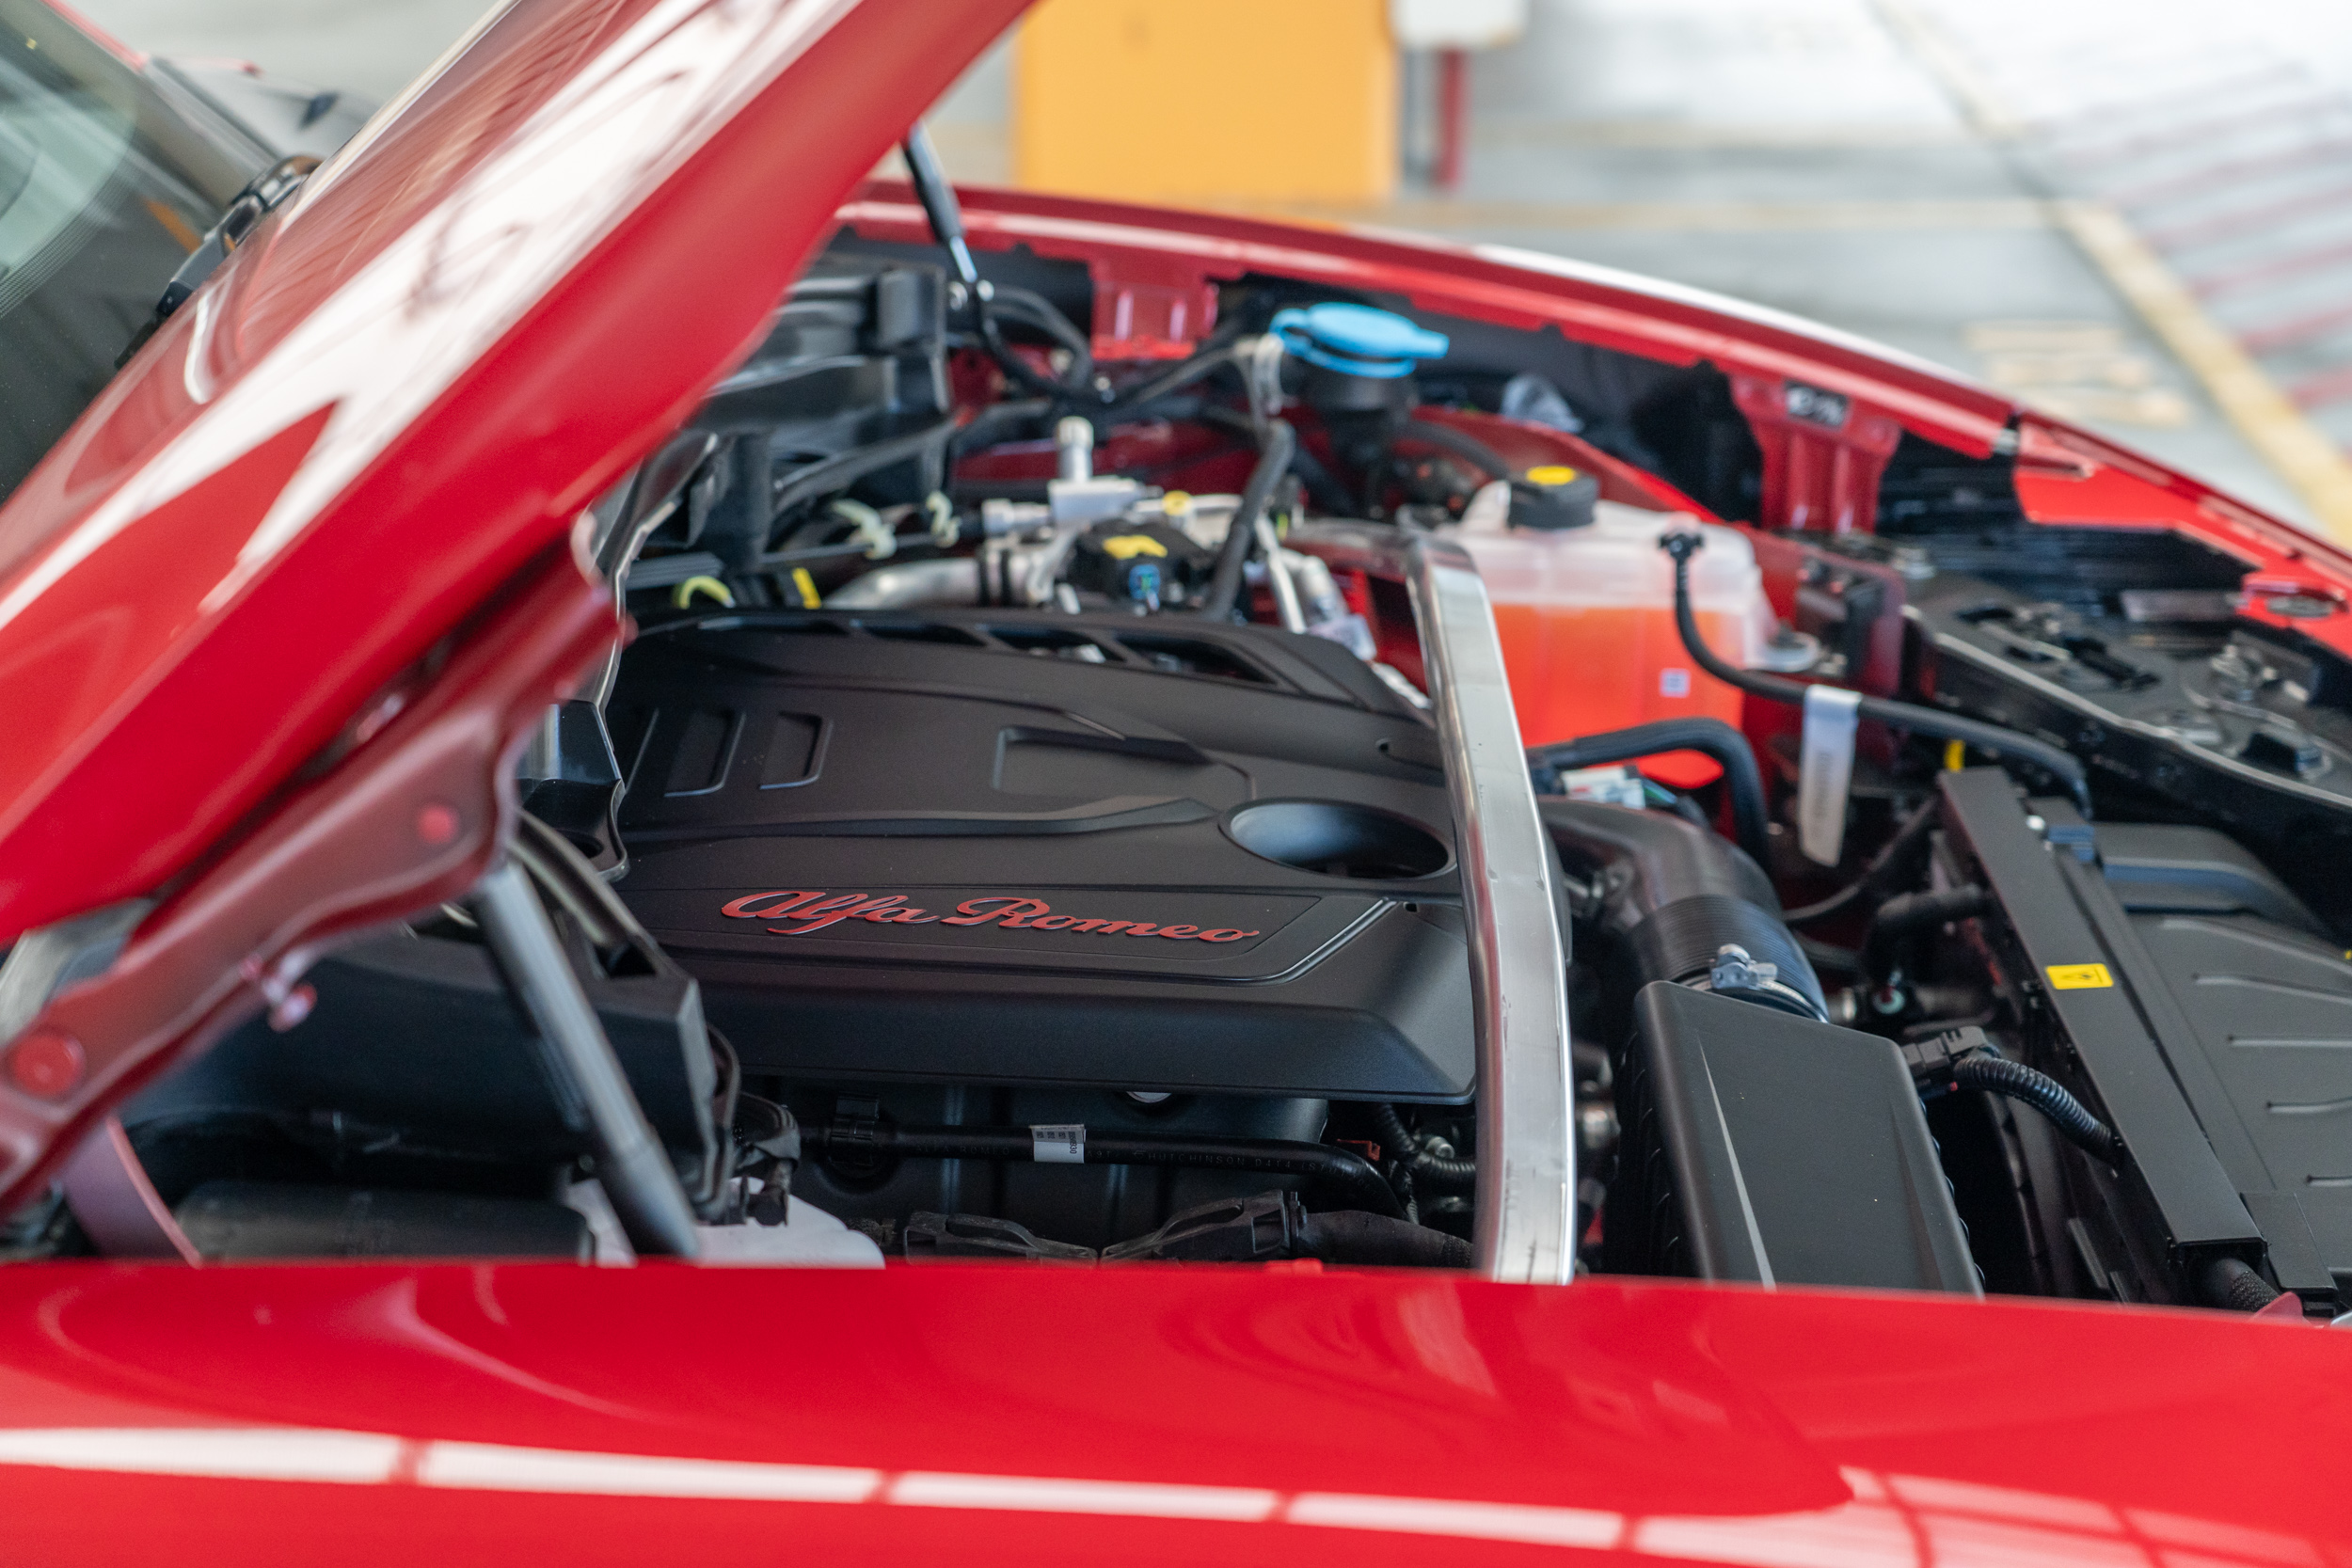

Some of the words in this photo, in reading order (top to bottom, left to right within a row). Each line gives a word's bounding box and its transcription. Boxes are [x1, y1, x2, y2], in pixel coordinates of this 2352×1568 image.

[720, 890, 941, 935] Alfa
[938, 895, 1261, 943] Romeo
[960, 1145, 1010, 1156] ROMEO
[1148, 1152, 1246, 1166] HUTCHINSON
